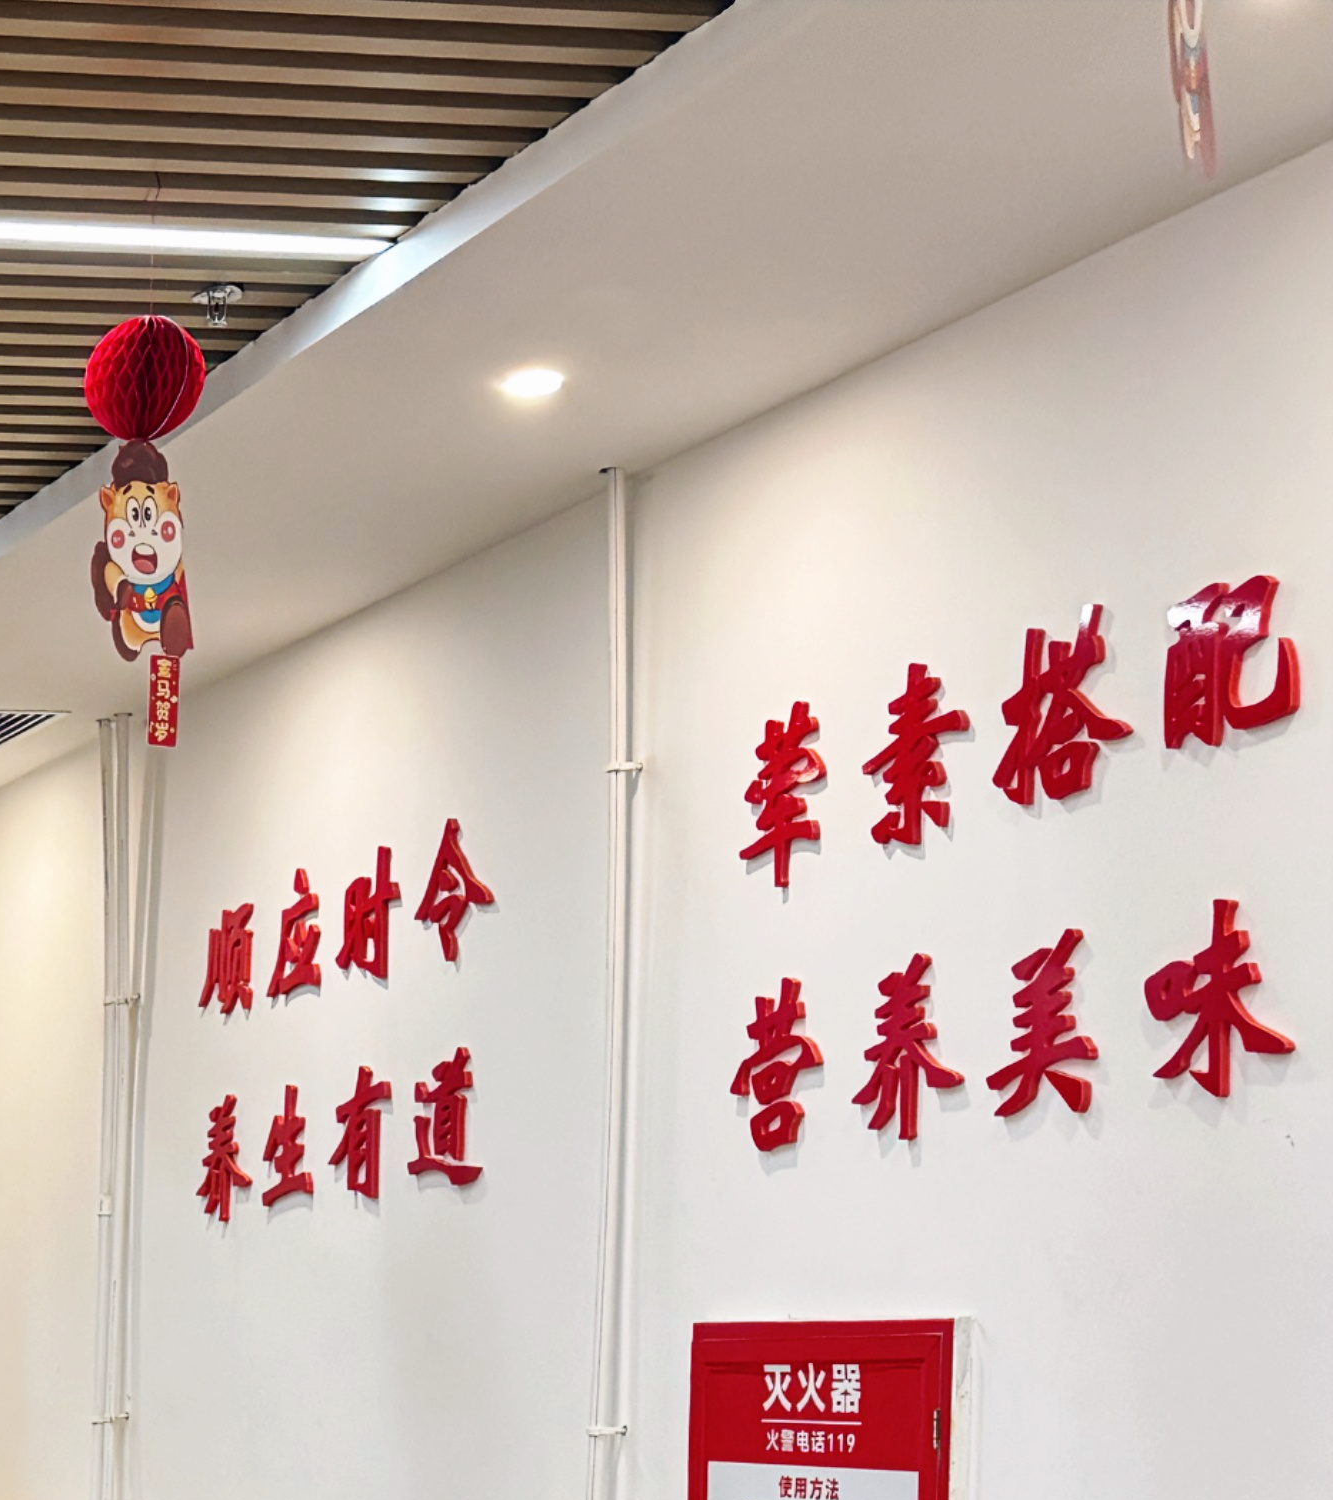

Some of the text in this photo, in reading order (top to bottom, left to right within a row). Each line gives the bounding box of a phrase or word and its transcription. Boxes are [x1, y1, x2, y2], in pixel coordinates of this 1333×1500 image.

[739, 575, 1301, 887] 荤素搭配
[198, 818, 495, 1013] 顺应时令
[729, 899, 1295, 1151] 营养美味
[196, 1047, 483, 1222] 养生有道
[762, 1362, 861, 1413] 灭火器
[765, 1429, 855, 1453] 火警电话119
[778, 1475, 840, 1500] 使用方法
